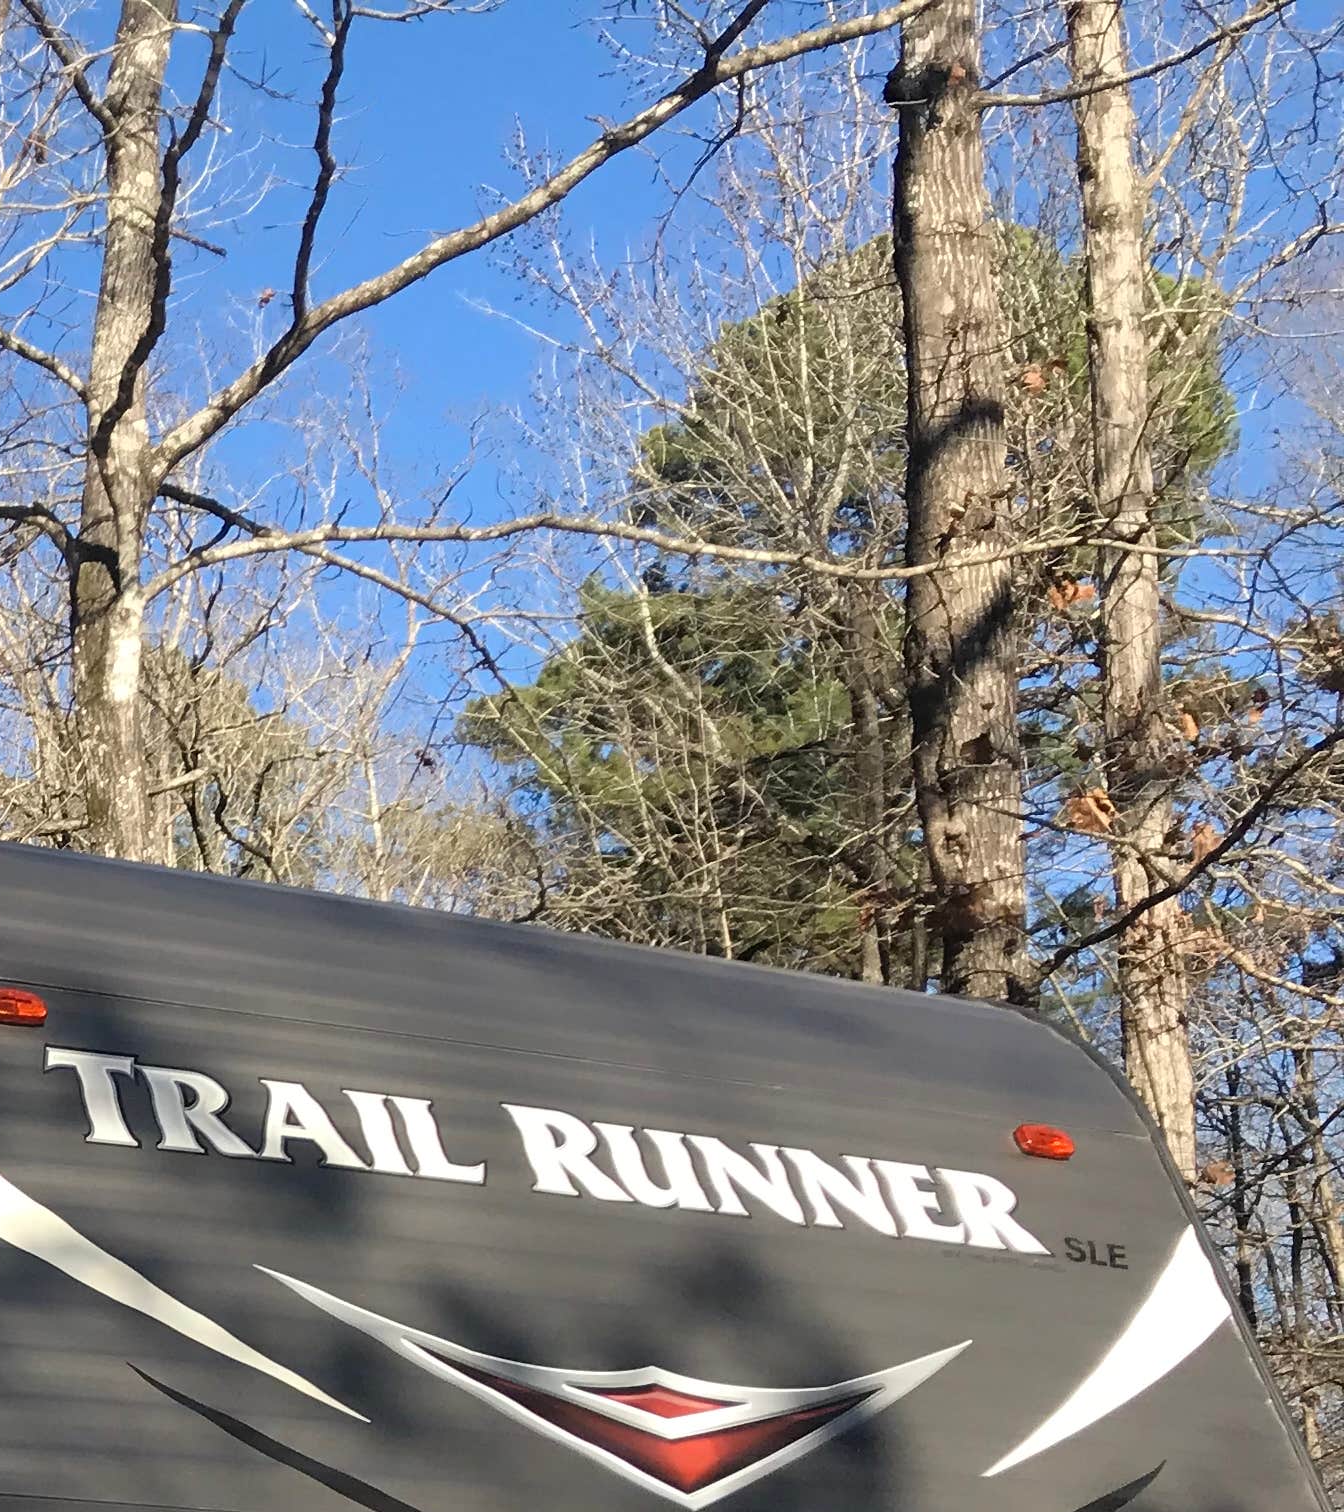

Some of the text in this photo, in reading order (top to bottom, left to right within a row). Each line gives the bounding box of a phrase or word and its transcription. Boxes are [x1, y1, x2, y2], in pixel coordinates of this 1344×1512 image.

[43, 1043, 1129, 1270] TRAIL RUNNER SLE
